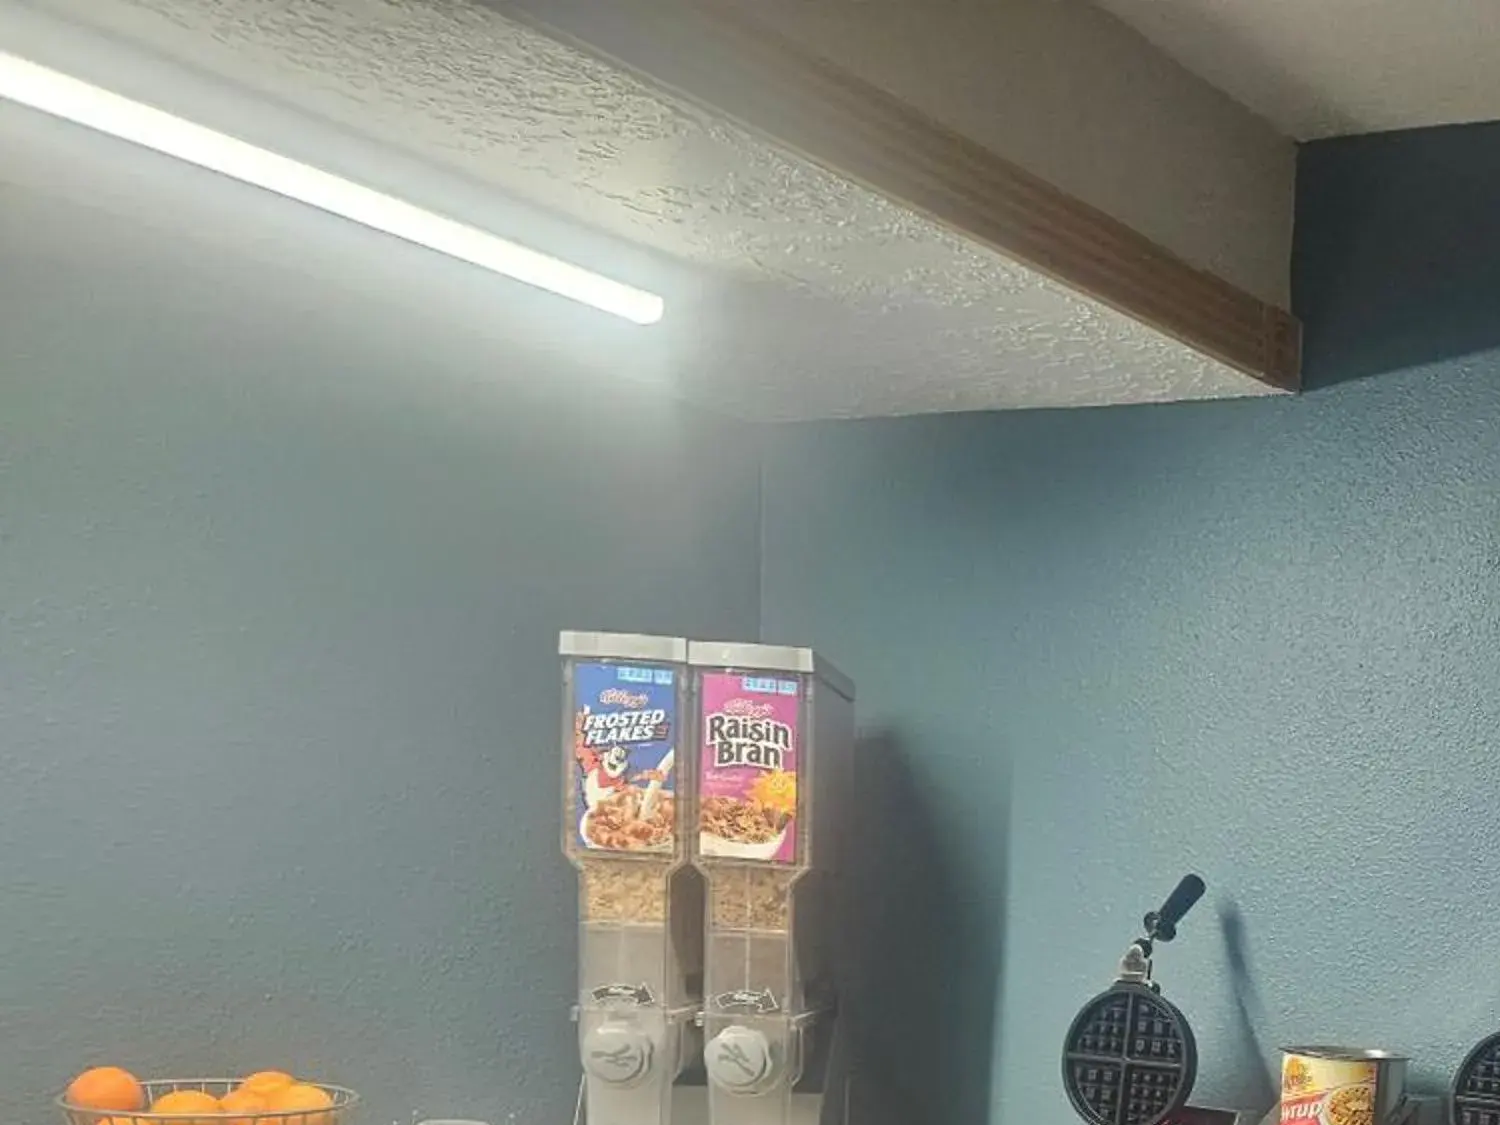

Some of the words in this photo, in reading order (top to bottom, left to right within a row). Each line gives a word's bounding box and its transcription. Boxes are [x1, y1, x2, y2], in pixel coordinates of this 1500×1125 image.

[583, 709, 665, 731] FROSTED
[707, 714, 791, 749] Raisin
[584, 725, 656, 746] FLAKES
[715, 740, 781, 768] Bran
